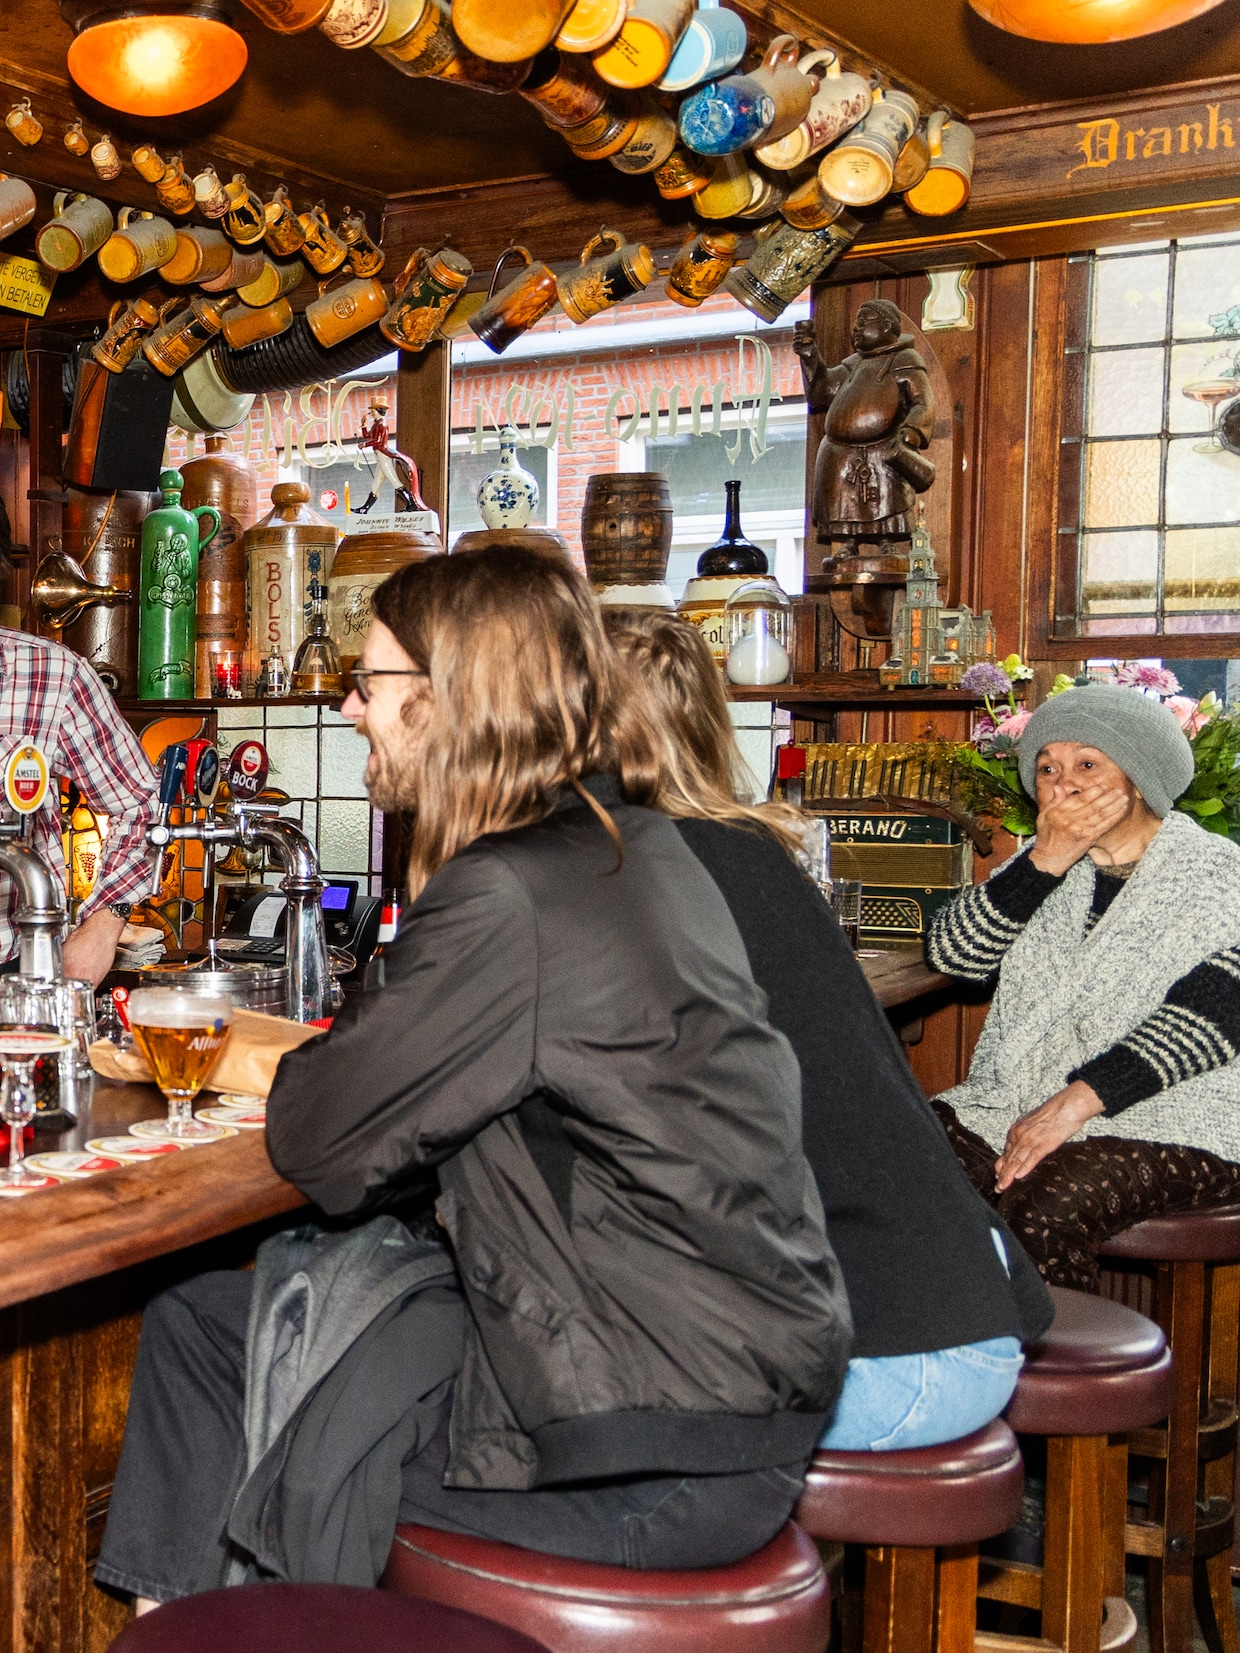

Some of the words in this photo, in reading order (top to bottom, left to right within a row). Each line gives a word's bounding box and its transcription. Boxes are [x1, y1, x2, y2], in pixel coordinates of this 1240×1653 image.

[1065, 103, 1240, 180] Drank
[6, 286, 47, 309] BETALEN
[266, 562, 282, 643] BOLS
[15, 769, 40, 778] AMSTEL
[232, 771, 258, 792] BOCK
[19, 782, 35, 790] BIER
